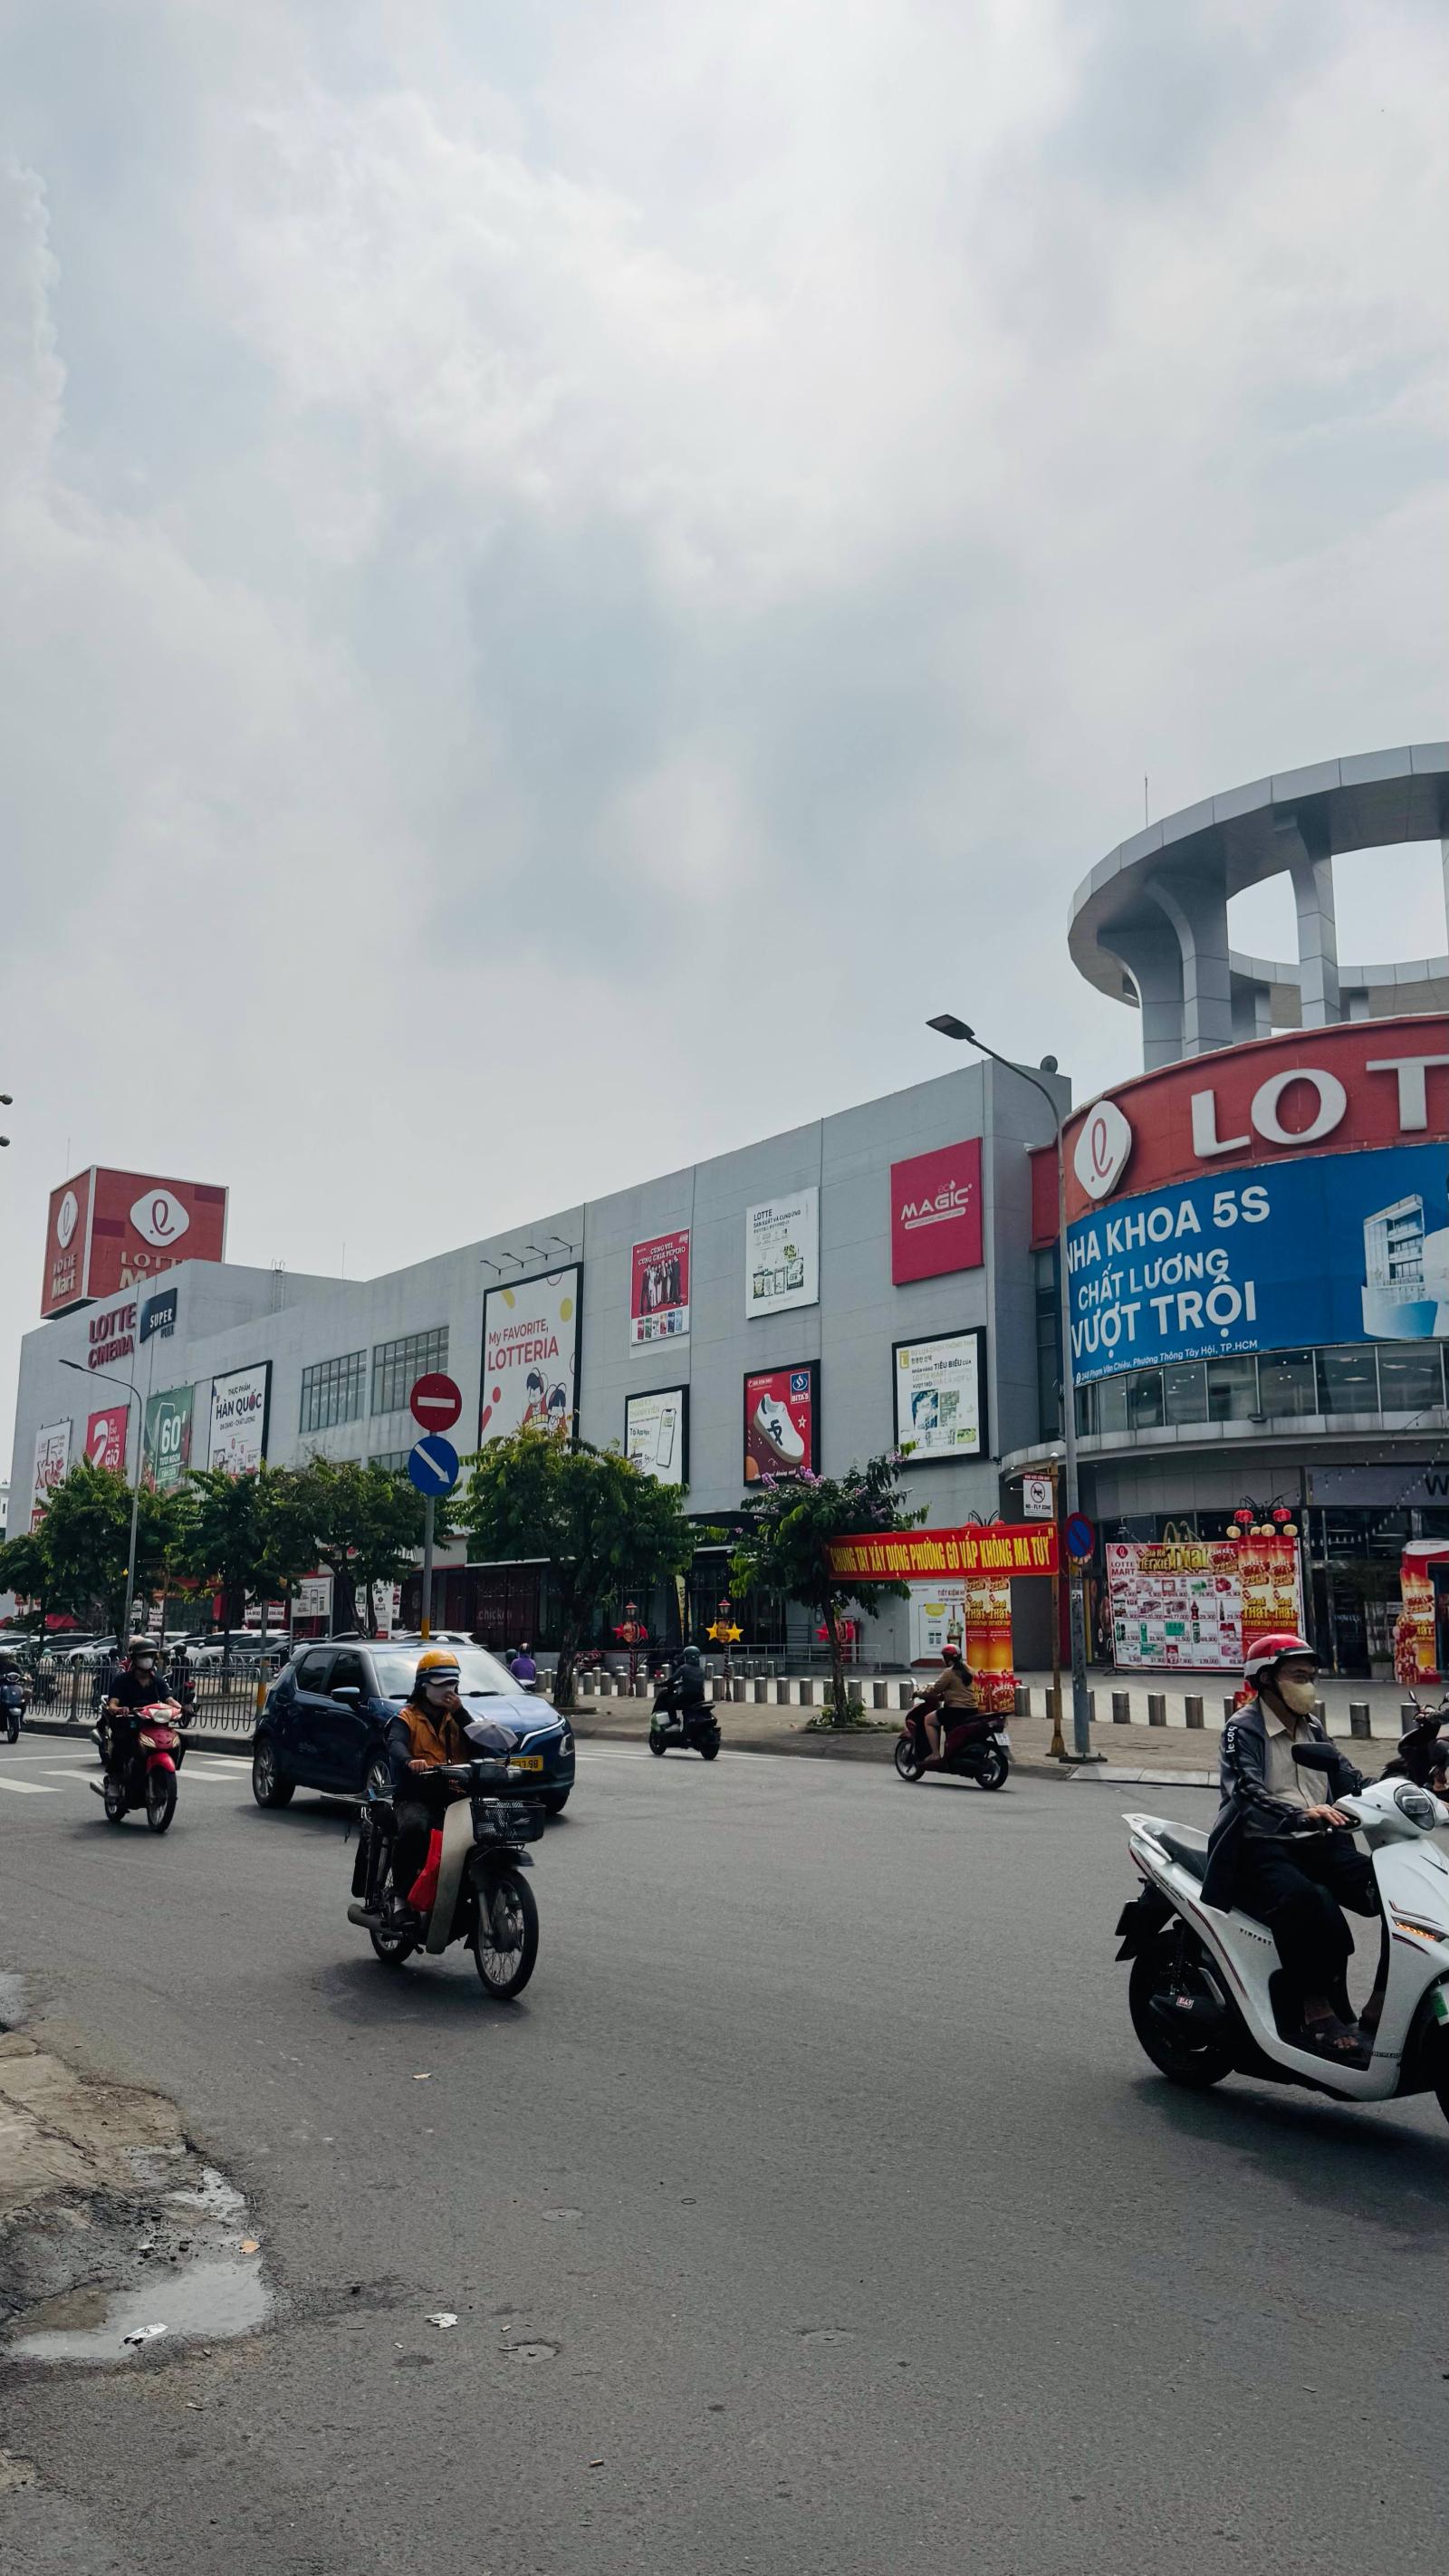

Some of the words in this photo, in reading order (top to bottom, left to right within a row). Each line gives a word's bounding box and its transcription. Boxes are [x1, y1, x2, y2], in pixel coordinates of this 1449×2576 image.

[753, 1208, 772, 1222] LOTTE
[900, 1187, 969, 1221] MAGIC
[1068, 1230, 1101, 1274] NHA
[1106, 1199, 1202, 1257] KHOA
[1213, 1186, 1271, 1228] 5S
[53, 1253, 77, 1276] LOTTE
[120, 1251, 184, 1268] LOTT
[52, 1270, 76, 1299] Mart
[1078, 1262, 1124, 1311] CHẤT
[89, 1302, 137, 1344] LOTTE
[149, 1307, 173, 1329] SUPER
[1070, 1302, 1141, 1359] VƯỢT
[1150, 1274, 1257, 1338] TRỘI
[488, 1331, 501, 1347] My
[503, 1318, 549, 1341] FAVORITE,
[88, 1334, 134, 1370] CINEMA
[487, 1335, 559, 1372] LOTTERIA
[1133, 1355, 1158, 1367] Phường
[1159, 1350, 1184, 1361] Thông
[1185, 1348, 1199, 1358] Tây
[1220, 1340, 1258, 1353] TP.HCM
[216, 1399, 234, 1419] HÀN
[235, 1389, 262, 1417] QUỐC
[792, 1392, 810, 1403] BITA'S
[856, 1546, 869, 1572] TAY
[868, 1540, 887, 1572] XÂY
[909, 1536, 945, 1572] PHƯỜNG
[945, 1533, 959, 1571] GÒ
[959, 1531, 978, 1569] VẤP
[980, 1533, 1013, 1569] KHÔNG
[1013, 1537, 1032, 1566] MA
[1111, 1568, 1135, 1576] MART
